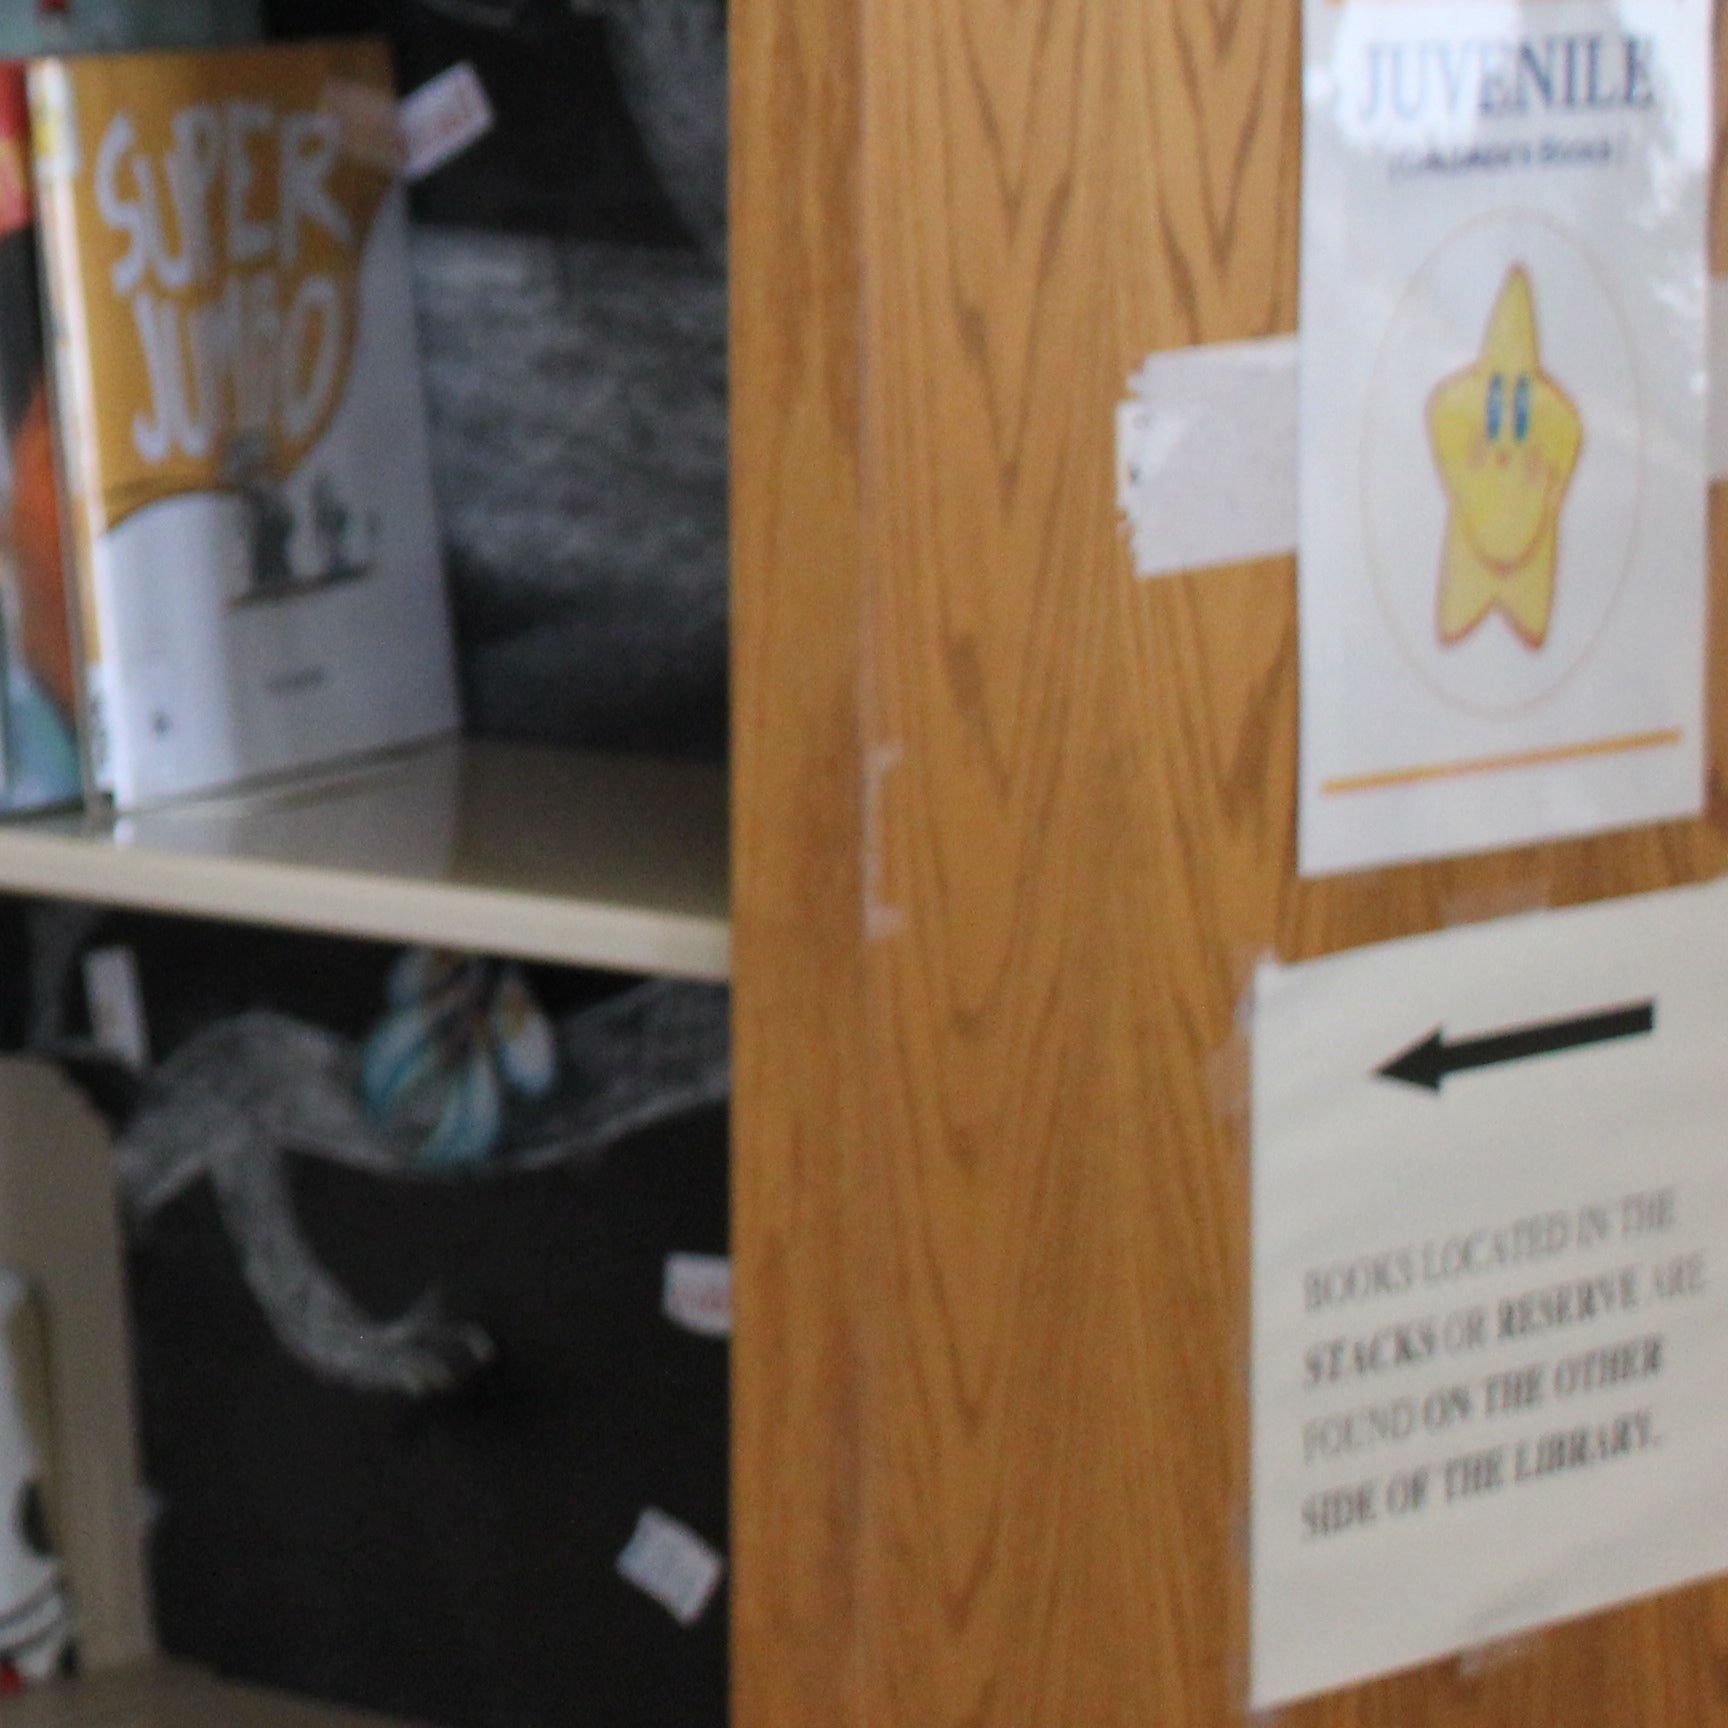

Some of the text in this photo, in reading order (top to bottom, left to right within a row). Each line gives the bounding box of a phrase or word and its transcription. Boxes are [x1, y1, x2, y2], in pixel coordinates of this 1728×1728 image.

[1359, 32, 1657, 123] JUVENILE
[95, 97, 355, 296] SUPER
[1304, 1185, 1679, 1313] BOOKS LOCATED IN THE
[1303, 1314, 1438, 1388] STACKS
[1496, 1262, 1640, 1341] RESERVE
[1302, 1332, 1665, 1466] FOUND ON THE OTHER
[1301, 1407, 1663, 1540] SIDE OF THE LIBRARY.
